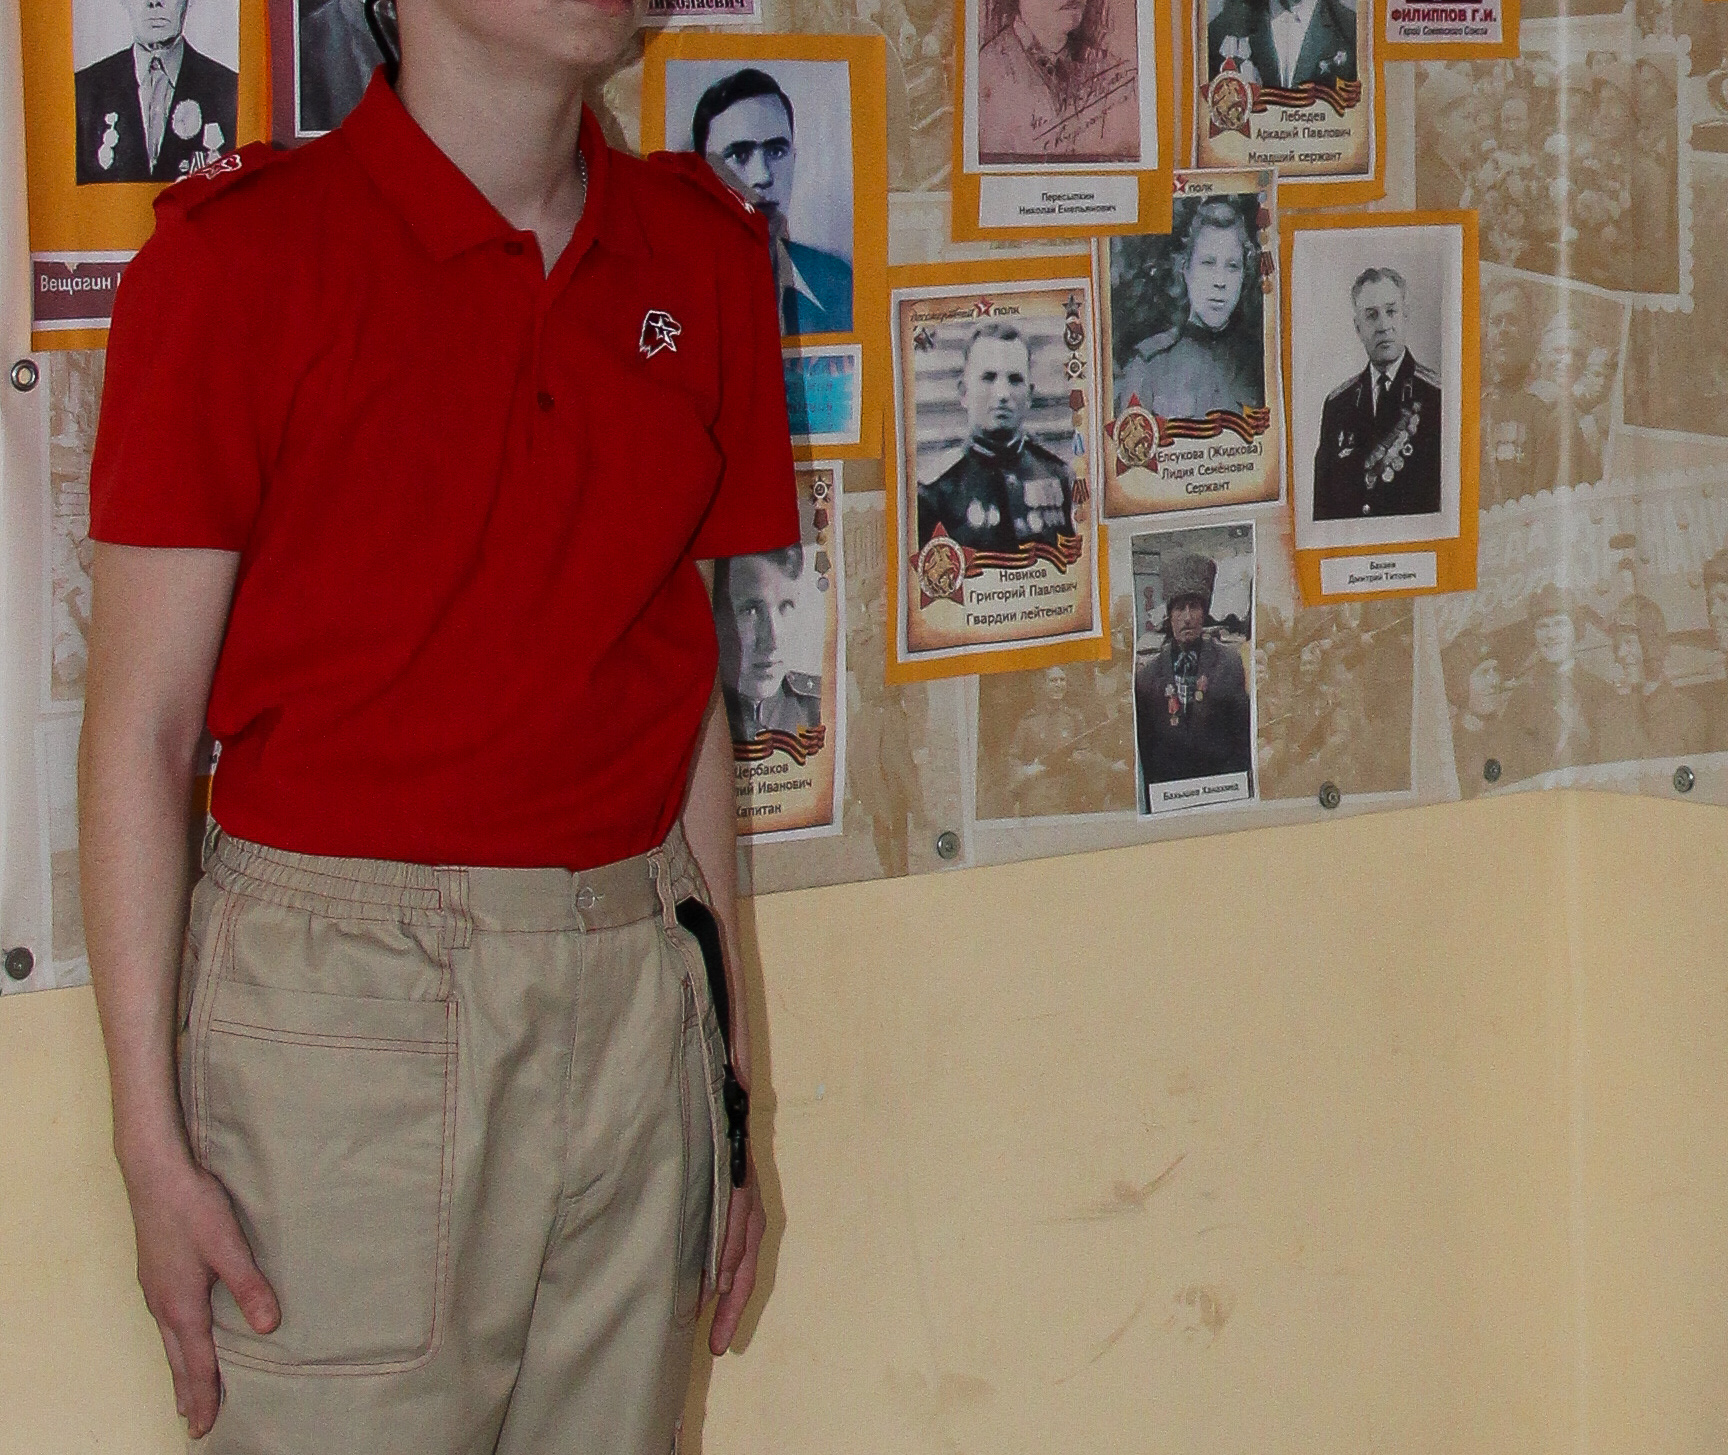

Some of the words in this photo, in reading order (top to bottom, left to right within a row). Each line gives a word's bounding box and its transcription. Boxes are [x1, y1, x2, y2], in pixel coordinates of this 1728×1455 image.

[1391, 8, 1467, 23] ФИЛИППОВ
[1471, 9, 1497, 23] Г.И.
[1280, 110, 1326, 123] Лебедев
[1256, 129, 1299, 142] Аркадий
[1302, 128, 1351, 140] Павлович
[1248, 151, 1295, 165] Младший
[1298, 151, 1342, 164] сержант
[1041, 192, 1095, 203] Пересыпкин
[1019, 205, 1056, 216] Николай
[1058, 204, 1117, 215] Емельянович
[40, 274, 111, 295] Вещагин
[995, 306, 1021, 317] полк
[1208, 442, 1263, 461] (Жидкова)
[1161, 466, 1194, 481] Лидия
[1198, 460, 1254, 477] Семёновна
[1185, 479, 1230, 496] Сержант
[999, 568, 1047, 583] Новиков
[970, 585, 1025, 604] Григорий
[1029, 581, 1078, 598] Павлович
[966, 610, 1017, 627] Гвардии
[1020, 603, 1074, 622] лейтенант
[758, 777, 812, 793] Иванович
